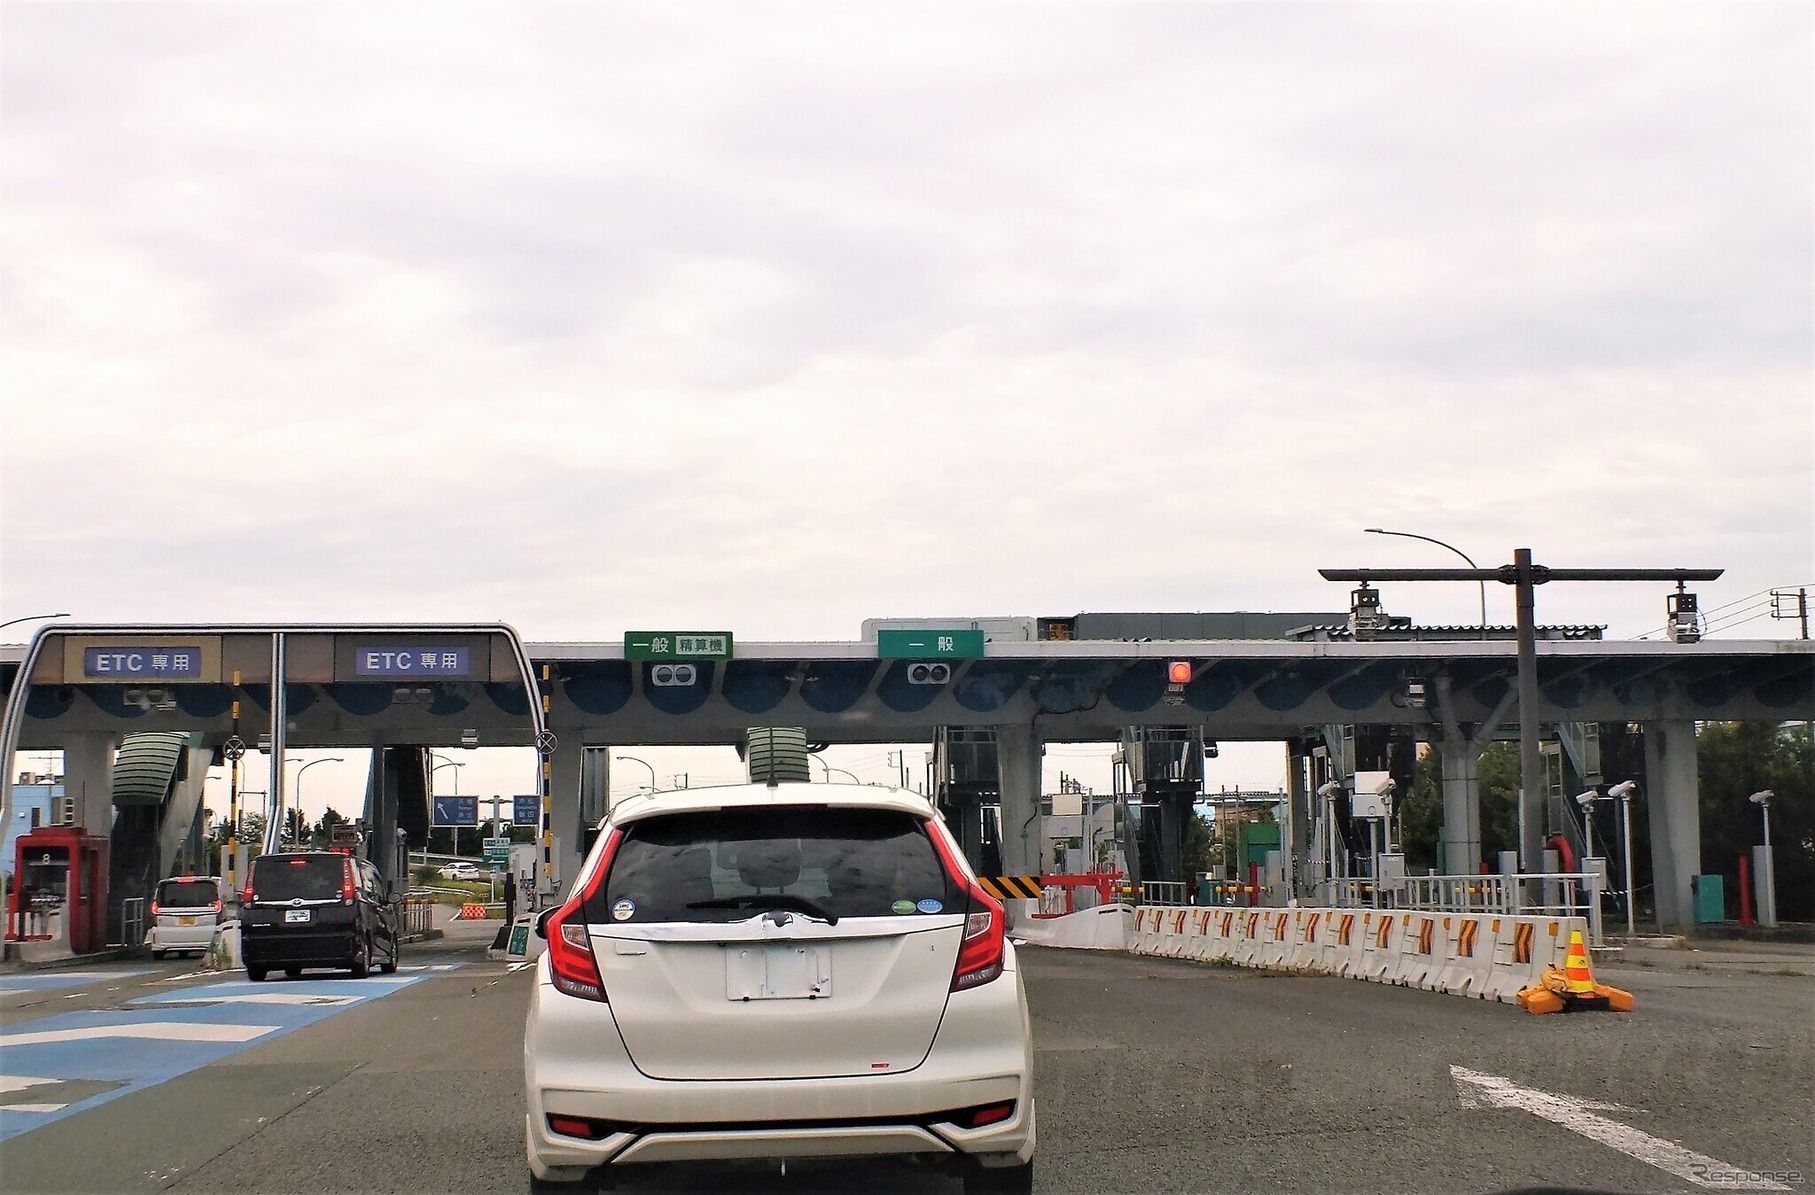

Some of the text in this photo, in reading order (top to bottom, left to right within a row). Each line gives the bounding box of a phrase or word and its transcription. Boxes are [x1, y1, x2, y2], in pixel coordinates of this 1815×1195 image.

[632, 637, 722, 653] 一般 精算機
[908, 636, 953, 652] 一般
[97, 654, 189, 671] ETC 専用
[366, 652, 457, 670] ETC 専用
